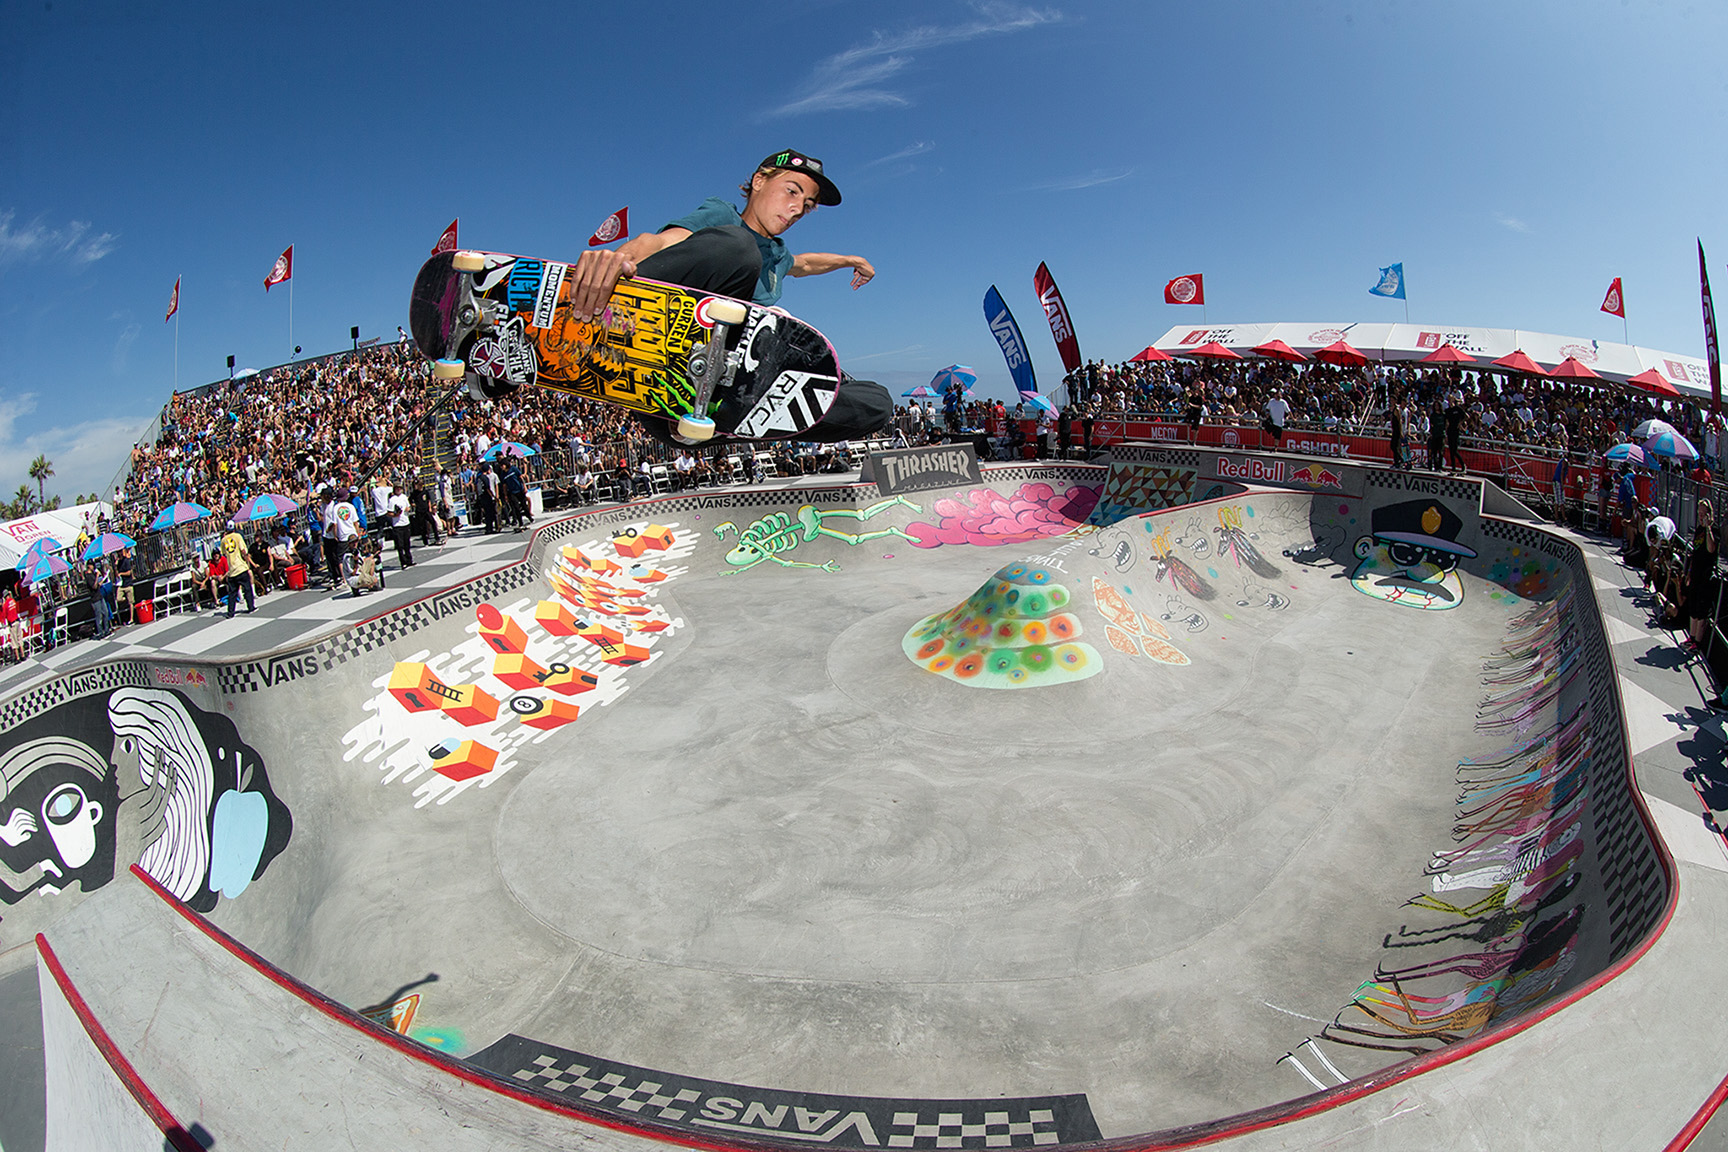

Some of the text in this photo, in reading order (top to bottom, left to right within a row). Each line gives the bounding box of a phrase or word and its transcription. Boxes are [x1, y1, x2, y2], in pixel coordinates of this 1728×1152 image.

[539, 264, 561, 328] MOMENTUM
[494, 303, 509, 338] FLIP
[667, 300, 695, 349] CURREN
[1040, 284, 1073, 343] VANS
[990, 309, 1027, 370] VANS
[520, 346, 535, 375] VANS
[737, 373, 798, 436] RVCA
[881, 449, 972, 490] THRASHER
[1138, 449, 1167, 463] VANS
[1217, 457, 1286, 483] Red Bull
[902, 479, 960, 491] MAGAZINE
[1023, 467, 1056, 480] VANS
[1403, 475, 1439, 494] VANS
[698, 495, 731, 509] VANS
[804, 489, 841, 503] VANS
[0, 520, 39, 536] VAN
[591, 510, 627, 526] VANS
[1540, 534, 1567, 559] VANS
[421, 587, 472, 621] VANS
[256, 648, 319, 688] VANS
[61, 669, 99, 698] VANS
[689, 1096, 881, 1146] VANS
